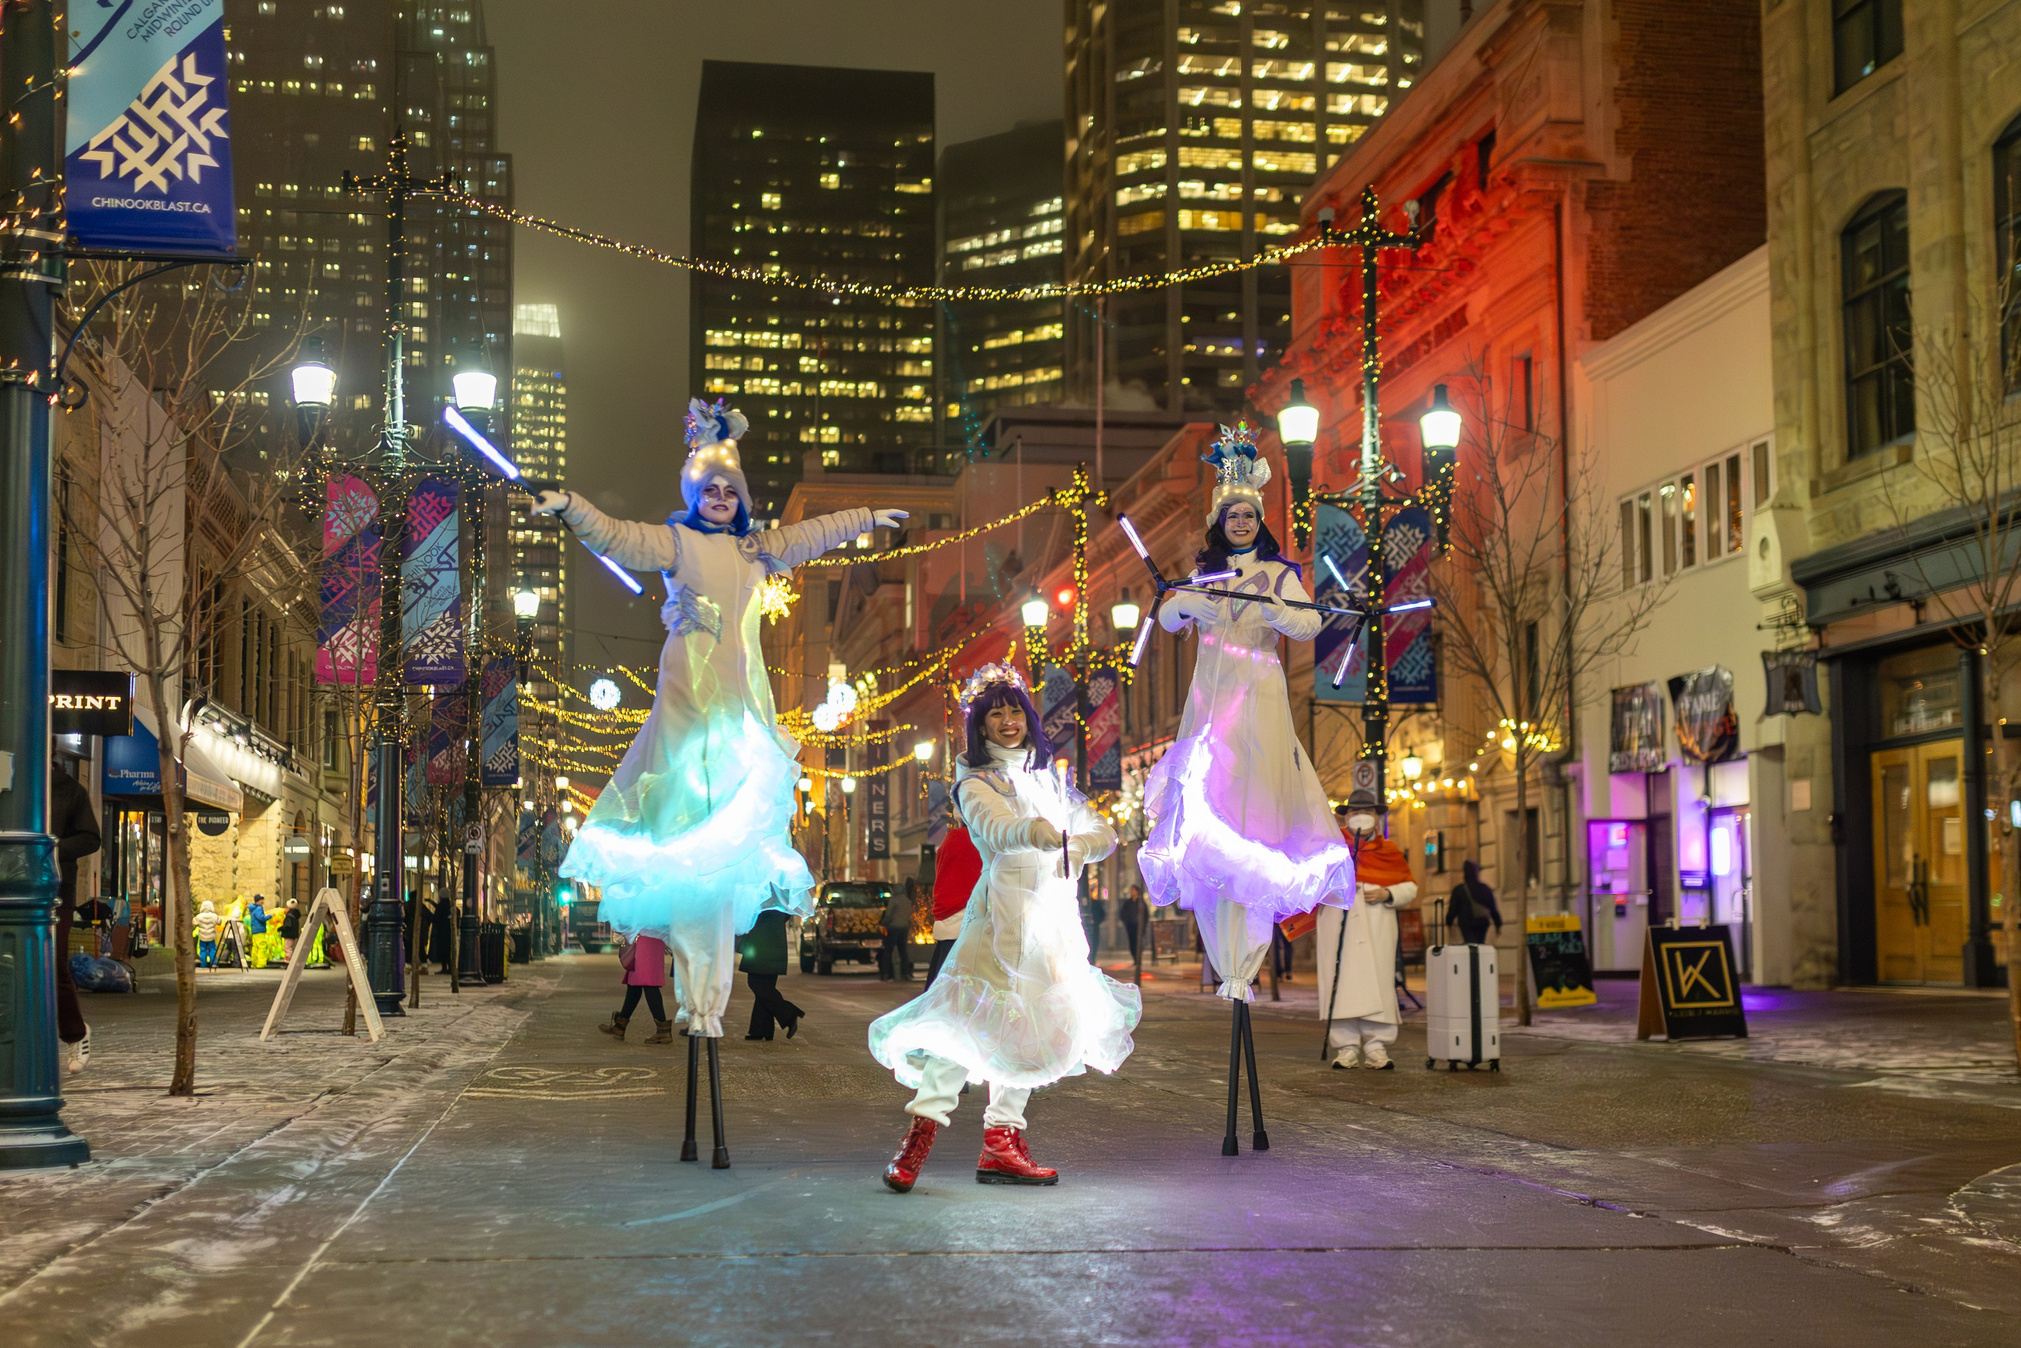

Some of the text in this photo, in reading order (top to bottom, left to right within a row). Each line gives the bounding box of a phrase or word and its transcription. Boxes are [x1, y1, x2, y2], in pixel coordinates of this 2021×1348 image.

[163, 3, 203, 38] ROUND
[92, 197, 211, 214] CHINOOKBLAST.CA
[120, 769, 155, 778] Pharma
[198, 816, 229, 824] THE PIONEER
